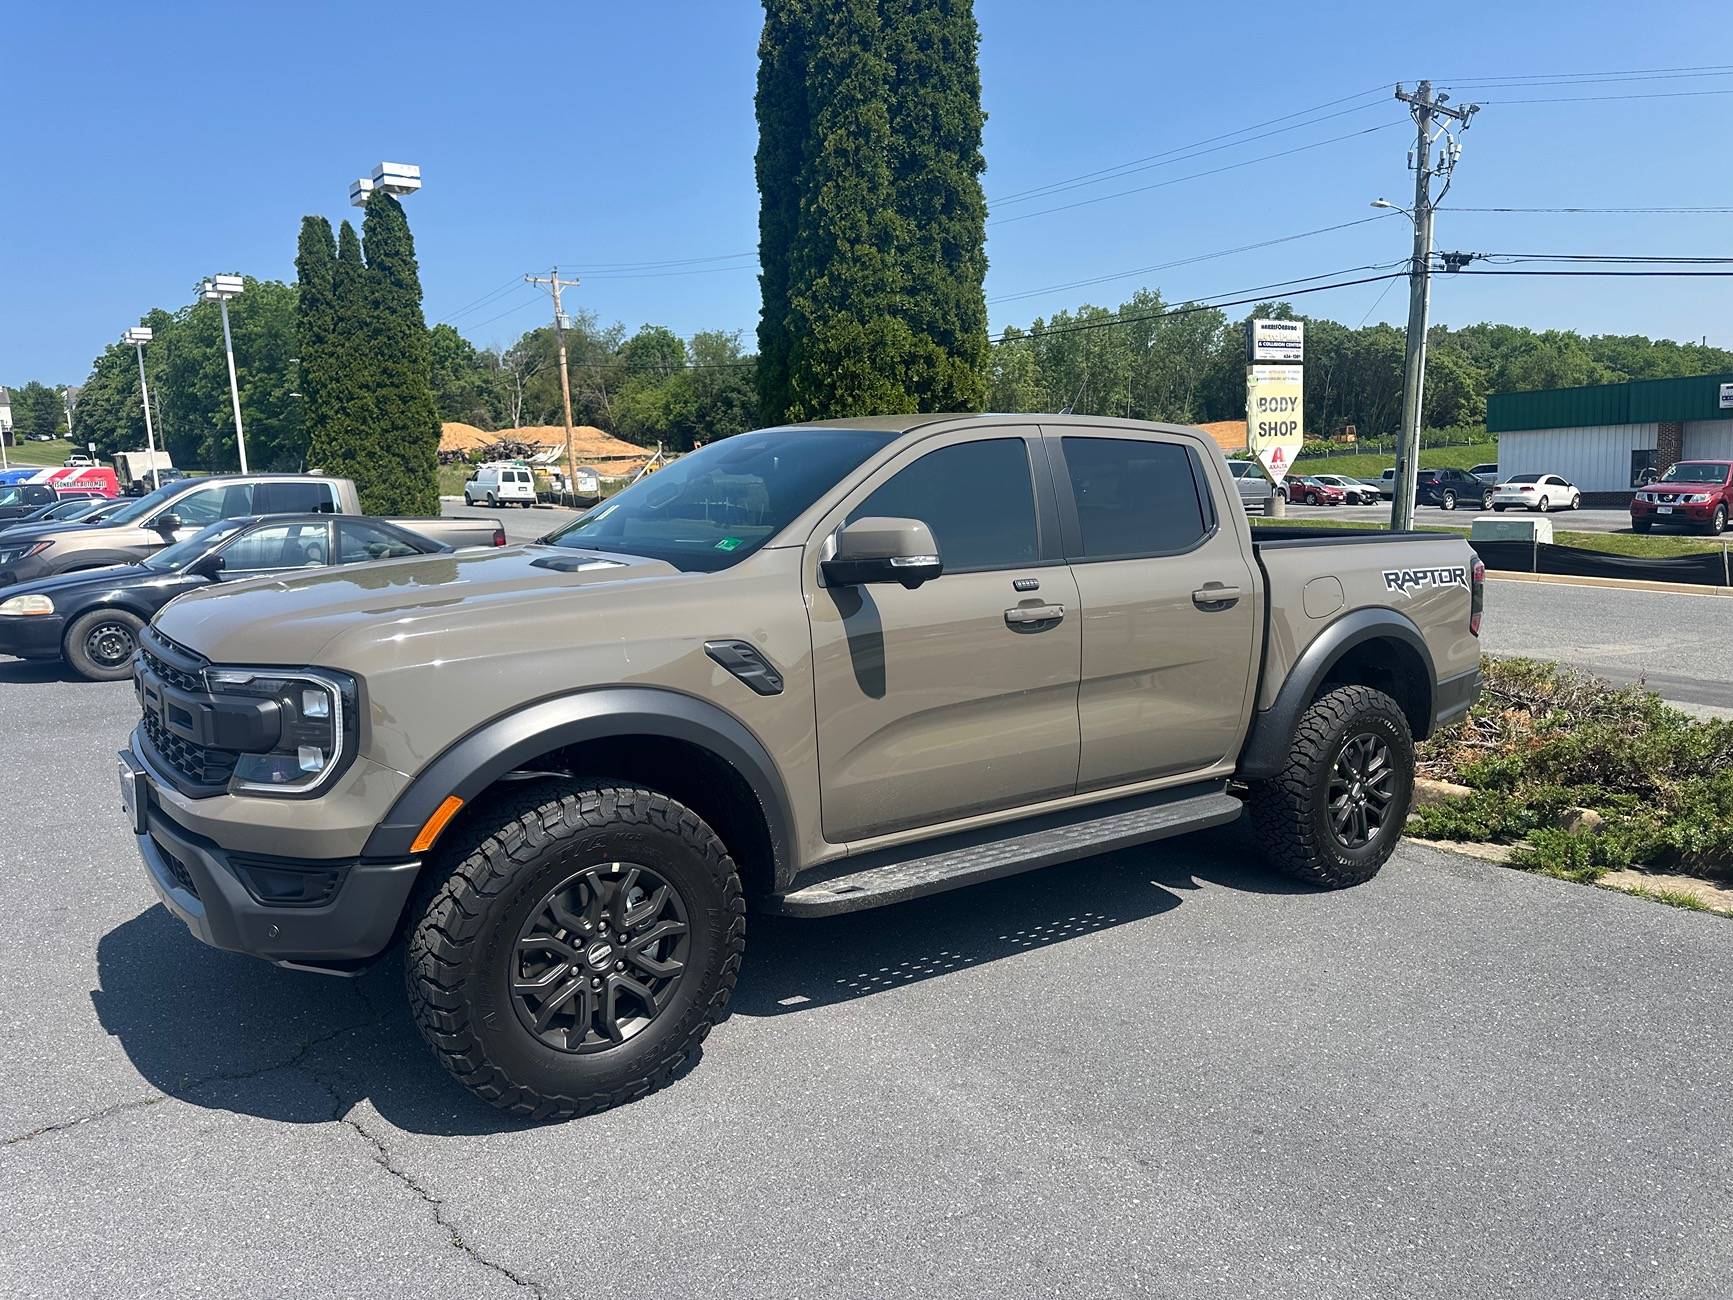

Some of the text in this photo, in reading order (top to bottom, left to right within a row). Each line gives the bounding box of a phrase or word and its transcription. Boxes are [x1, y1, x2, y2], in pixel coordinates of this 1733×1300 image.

[1259, 396, 1298, 412] BODY
[1258, 420, 1297, 437] SHOP
[1382, 566, 1470, 599] RAPTOR
